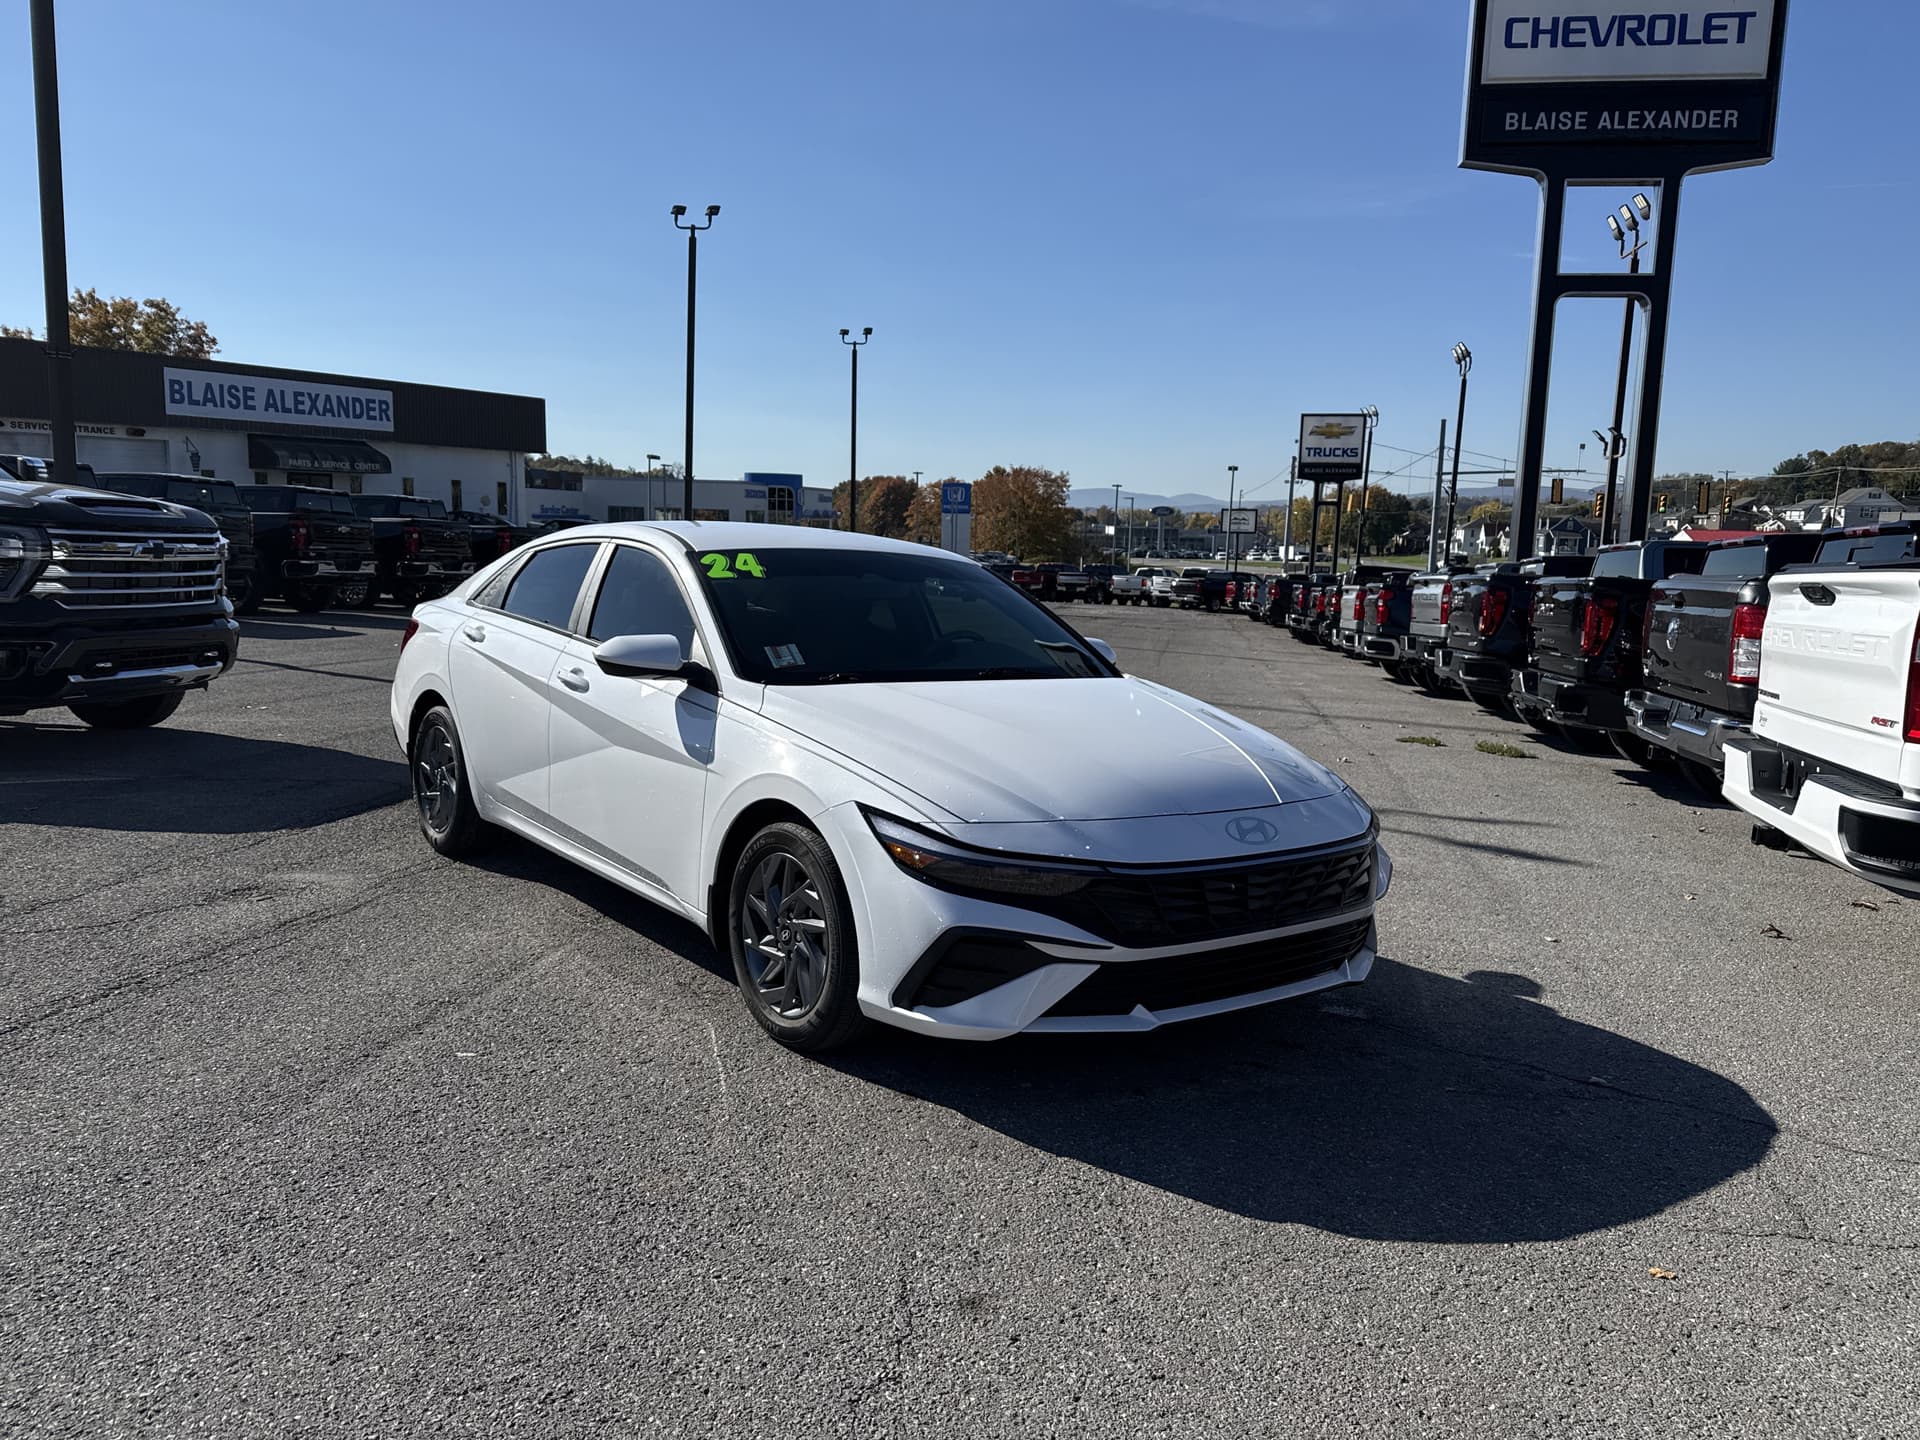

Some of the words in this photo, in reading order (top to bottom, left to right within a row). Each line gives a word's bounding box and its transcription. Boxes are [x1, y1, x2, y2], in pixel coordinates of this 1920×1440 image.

[1504, 11, 1757, 49] CHEVROLET
[1504, 111, 1588, 131] BLAISE
[1597, 109, 1739, 130] ALEXANDER
[168, 378, 257, 411] BLAISE
[263, 388, 392, 422] ALEXANDER
[75, 424, 116, 435] TRANCE
[1305, 447, 1359, 458] TRUCKS
[288, 458, 312, 468] PARTS
[321, 460, 352, 470] SERVICE
[354, 462, 380, 472] CENTER
[700, 552, 766, 579] 24
